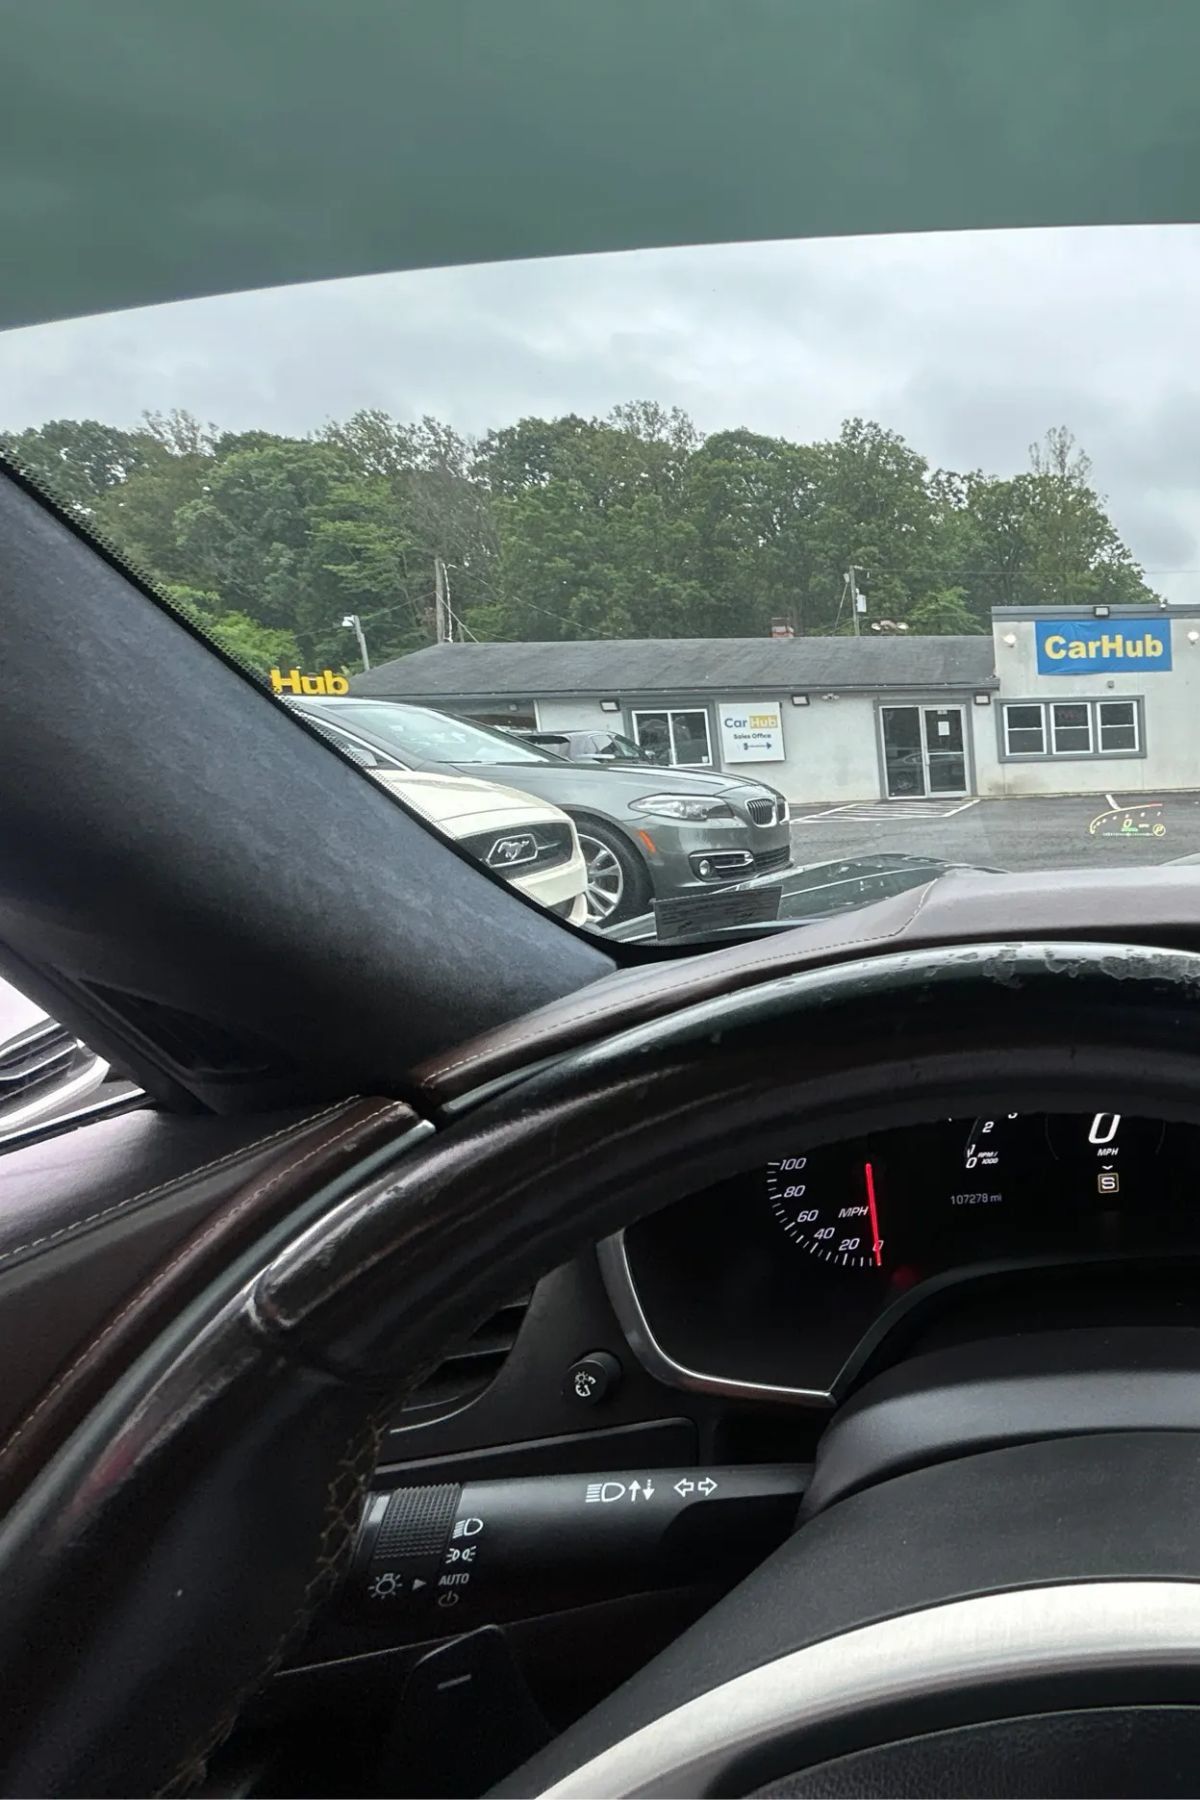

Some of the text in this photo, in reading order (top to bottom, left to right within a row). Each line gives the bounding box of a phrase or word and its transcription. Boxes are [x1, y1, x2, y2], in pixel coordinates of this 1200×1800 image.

[1044, 633, 1163, 659] CarHub
[271, 668, 350, 695] Hub
[724, 716, 777, 728] Car Hub
[982, 1121, 995, 1133] 2
[1088, 1112, 1121, 1144] 0
[1097, 1147, 1119, 1157] MPH
[780, 1157, 807, 1171] 100
[965, 1157, 978, 1169] 0
[1101, 1176, 1116, 1190] S
[783, 1185, 806, 1198] 80
[950, 1193, 1002, 1205] 107278 mi
[797, 1209, 819, 1222] 60
[838, 1206, 869, 1218] MPH
[813, 1227, 835, 1240] 40
[838, 1238, 860, 1252] 20
[438, 1572, 470, 1586] AUTO
